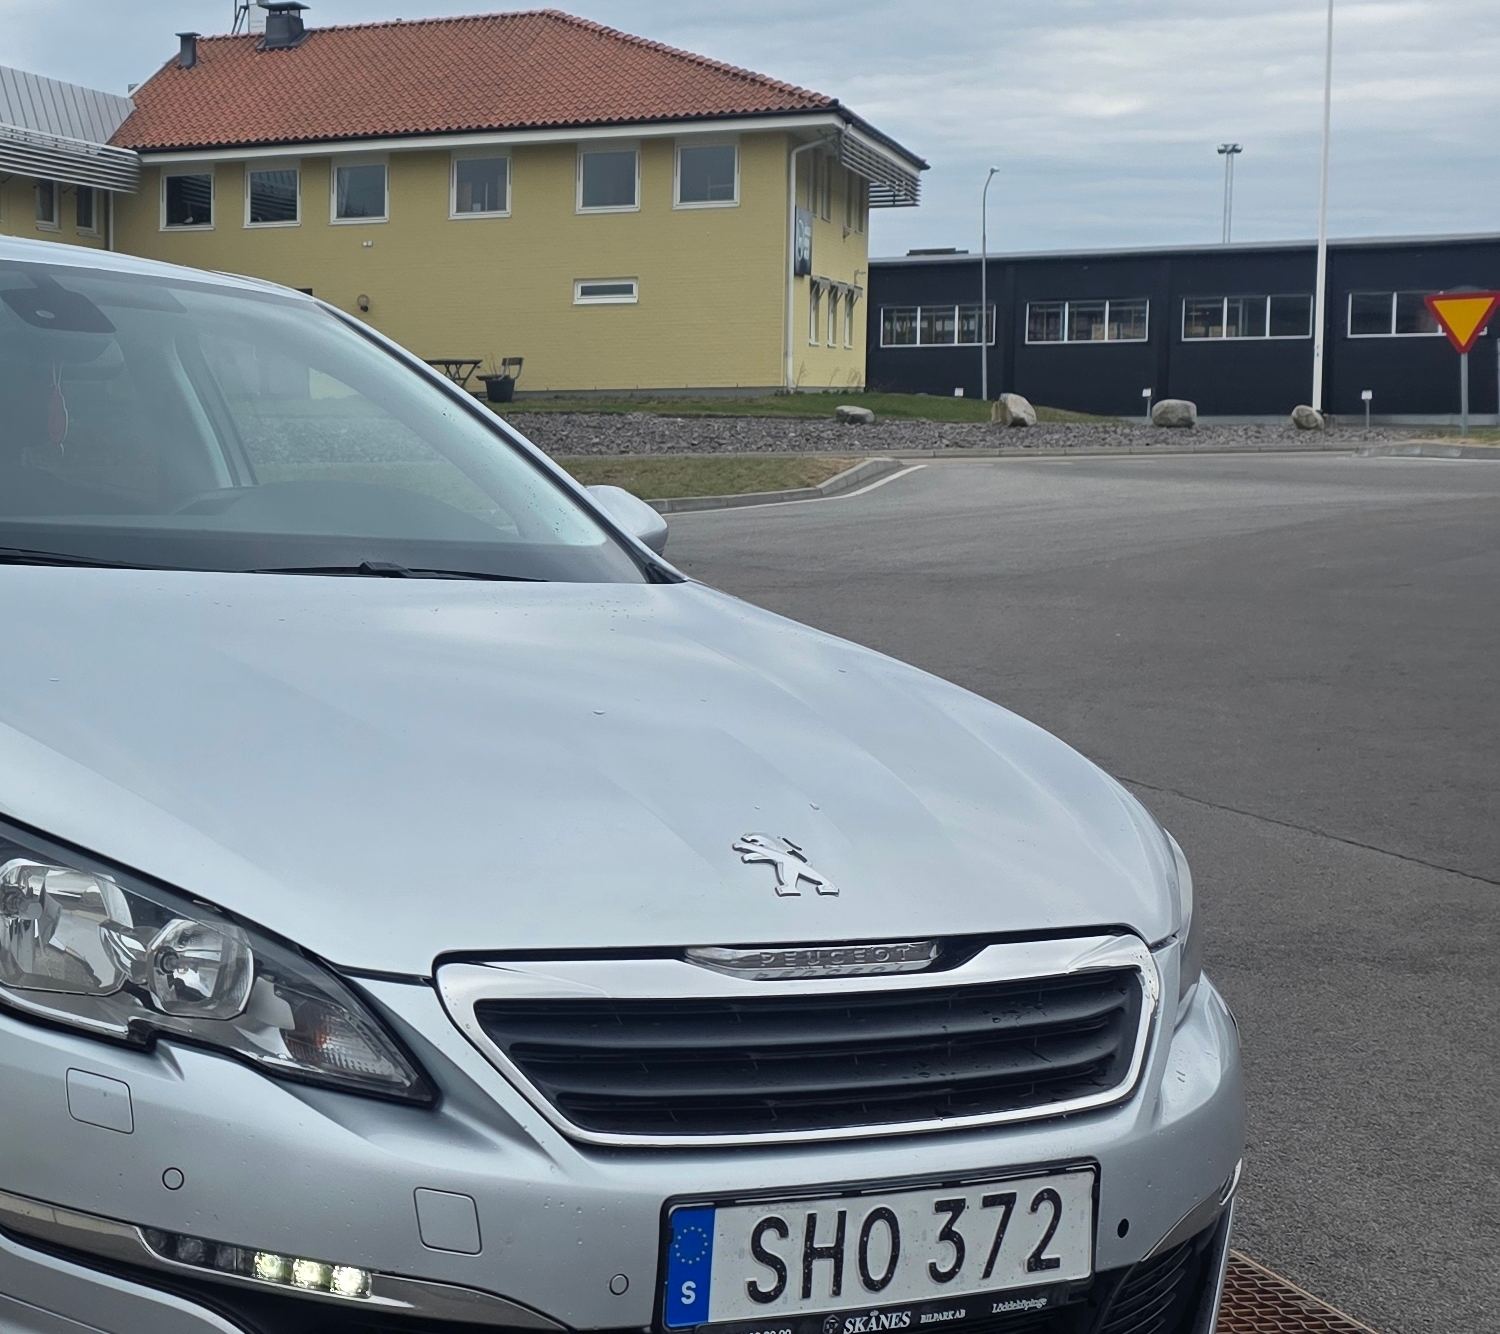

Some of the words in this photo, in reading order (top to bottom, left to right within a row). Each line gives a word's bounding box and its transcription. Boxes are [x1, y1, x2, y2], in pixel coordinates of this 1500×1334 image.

[760, 948, 910, 967] PEUGEOT
[746, 1206, 901, 1305] SHO
[928, 1187, 1063, 1284] 372
[681, 1280, 697, 1305] S
[843, 1310, 912, 1334] SKÅNES
[920, 1310, 954, 1323] BILPARK
[955, 1309, 966, 1319] AB
